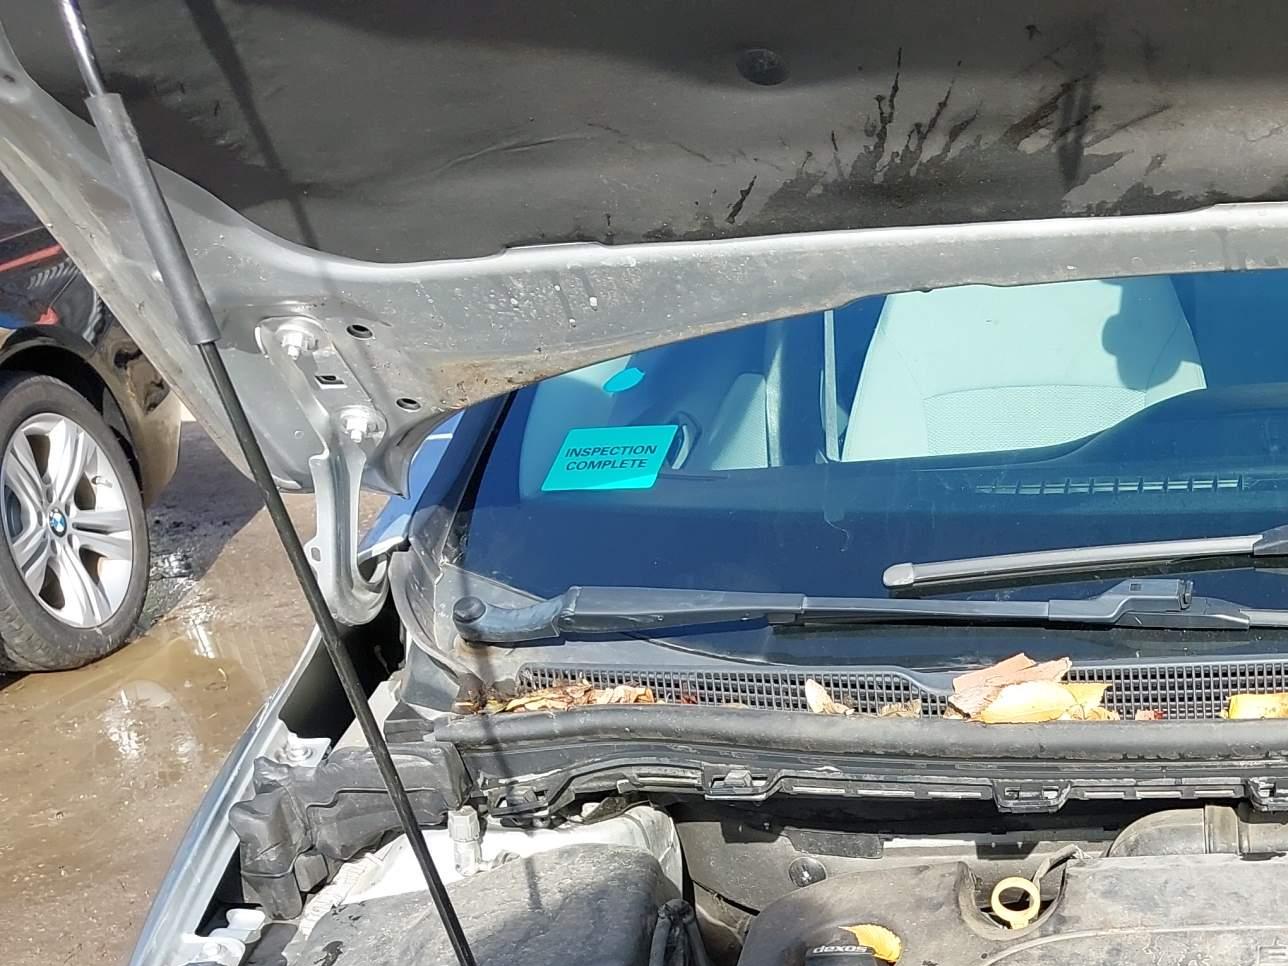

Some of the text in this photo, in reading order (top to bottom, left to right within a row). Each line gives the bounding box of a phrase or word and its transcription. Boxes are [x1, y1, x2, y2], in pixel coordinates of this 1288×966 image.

[565, 445, 657, 458] INSPECTION
[566, 458, 647, 471] COMPLETE
[812, 945, 867, 954] dexos
